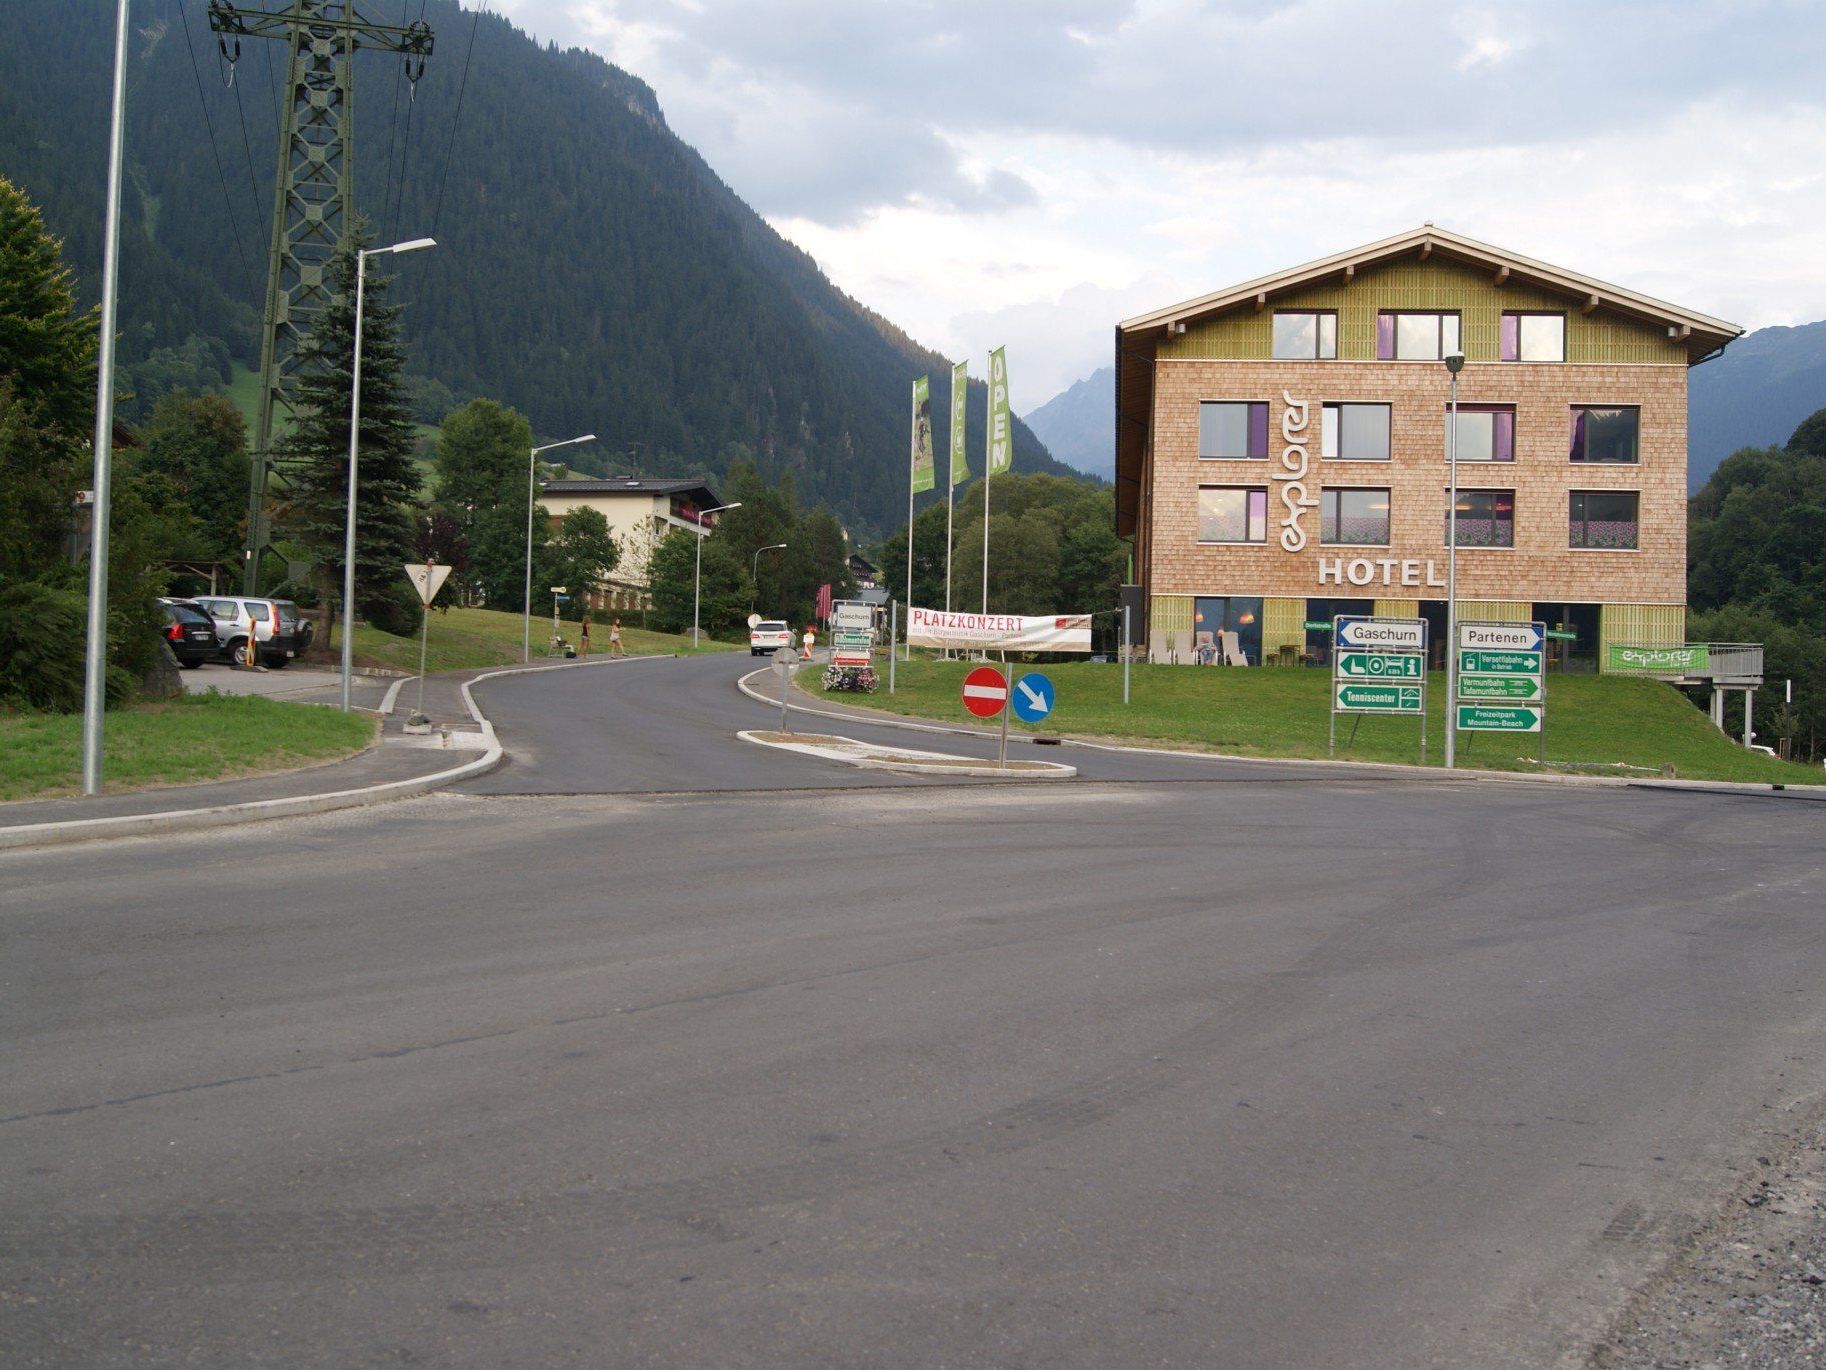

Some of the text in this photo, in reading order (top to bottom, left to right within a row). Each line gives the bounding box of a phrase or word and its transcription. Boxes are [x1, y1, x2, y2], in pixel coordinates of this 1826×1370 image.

[993, 355, 1007, 469] OPEN
[1271, 389, 1320, 552] explorer
[1318, 558, 1446, 586] HOTEL
[839, 612, 870, 620] Gaschurn
[913, 610, 1024, 631] PLATZKONZERT
[1353, 626, 1417, 641] Gaschurn
[1469, 630, 1527, 643] Partenen
[1622, 649, 1696, 666] explorer
[1347, 691, 1396, 703] Tenniscenter
[1475, 710, 1516, 719] Freizeitpark
[1467, 719, 1524, 728] Mountain-Beach
